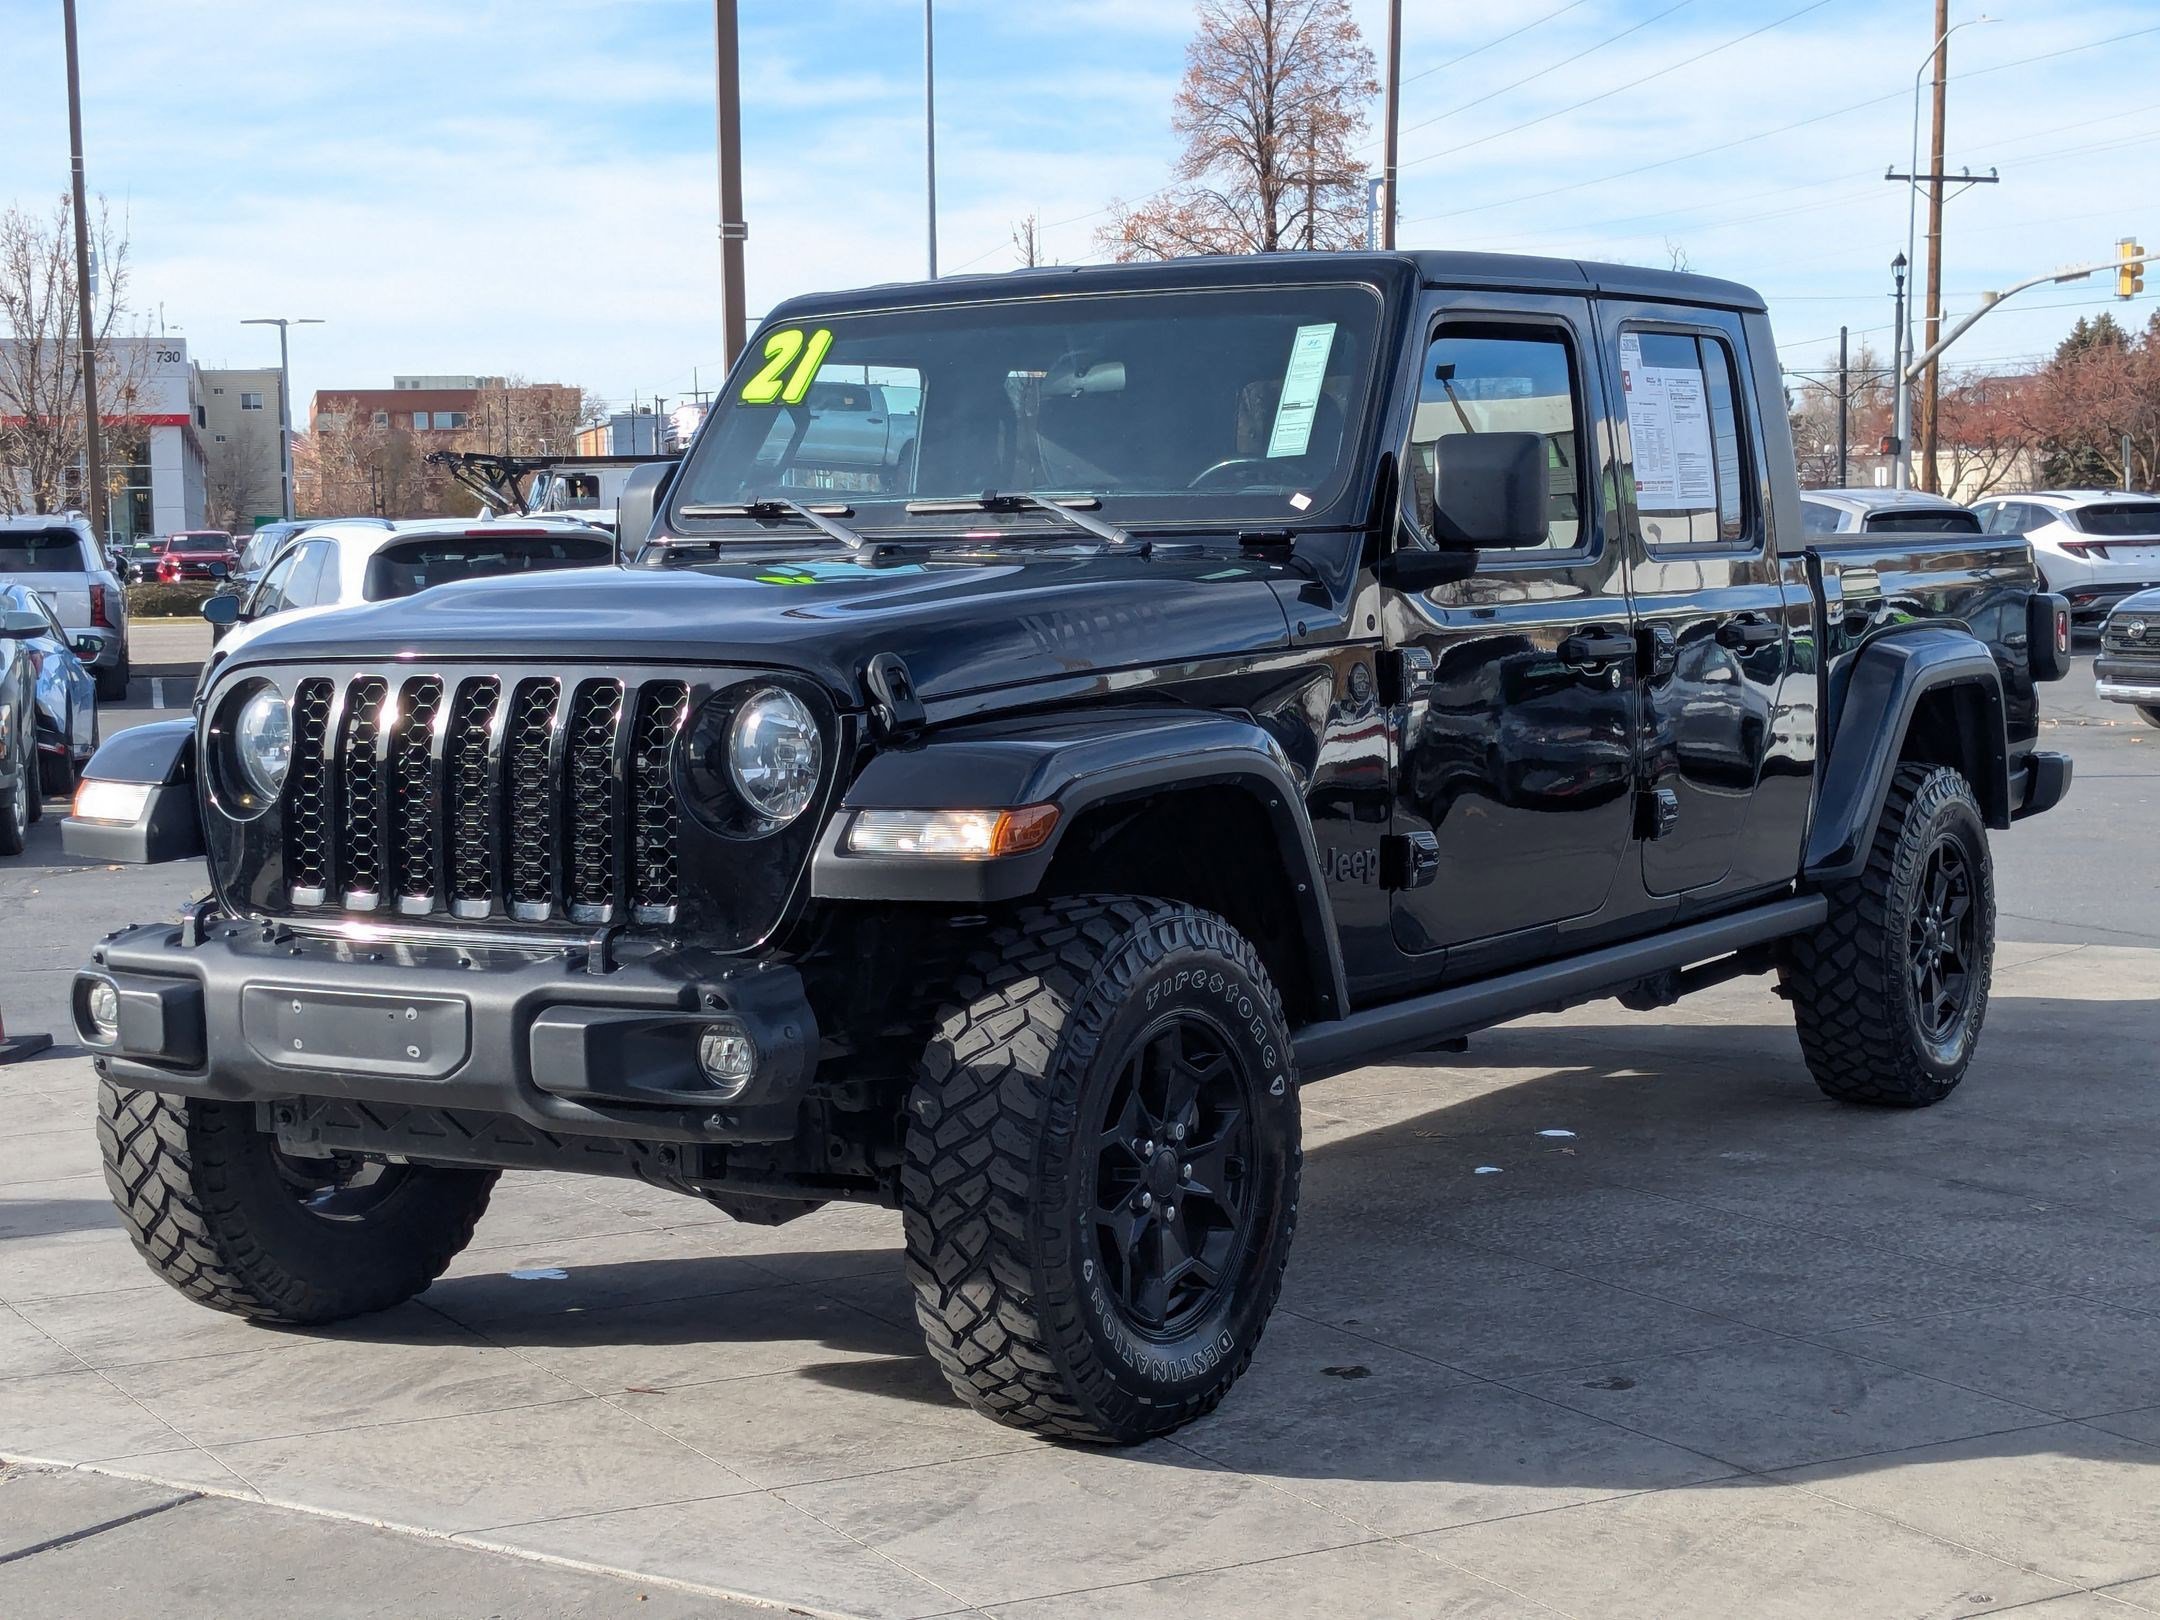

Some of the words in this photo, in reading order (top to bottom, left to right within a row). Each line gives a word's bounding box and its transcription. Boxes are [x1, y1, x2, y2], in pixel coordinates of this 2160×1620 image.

[156, 351, 181, 363] 730
[741, 329, 834, 406] 21
[1323, 846, 1378, 885] Jeep
[1146, 969, 1276, 1069] Firestone
[1091, 1287, 1235, 1383] DESTINATION
